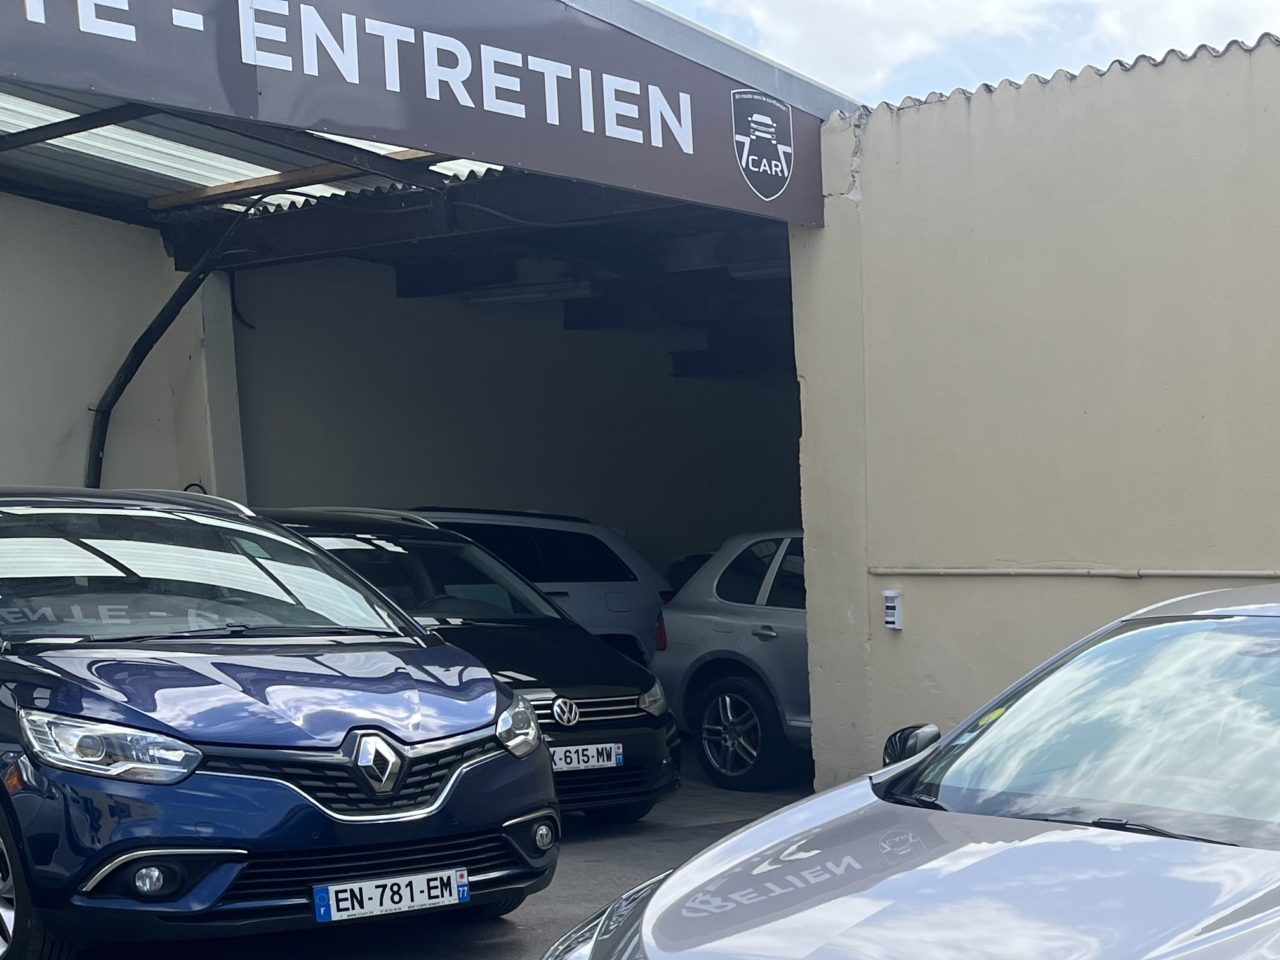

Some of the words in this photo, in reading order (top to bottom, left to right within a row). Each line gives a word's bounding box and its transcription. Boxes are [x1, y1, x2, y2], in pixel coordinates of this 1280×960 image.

[237, 0, 694, 155] ENTRETIEN
[320, 907, 326, 915] F
[334, 875, 453, 912] EN-781-EM
[458, 886, 468, 898] 77
